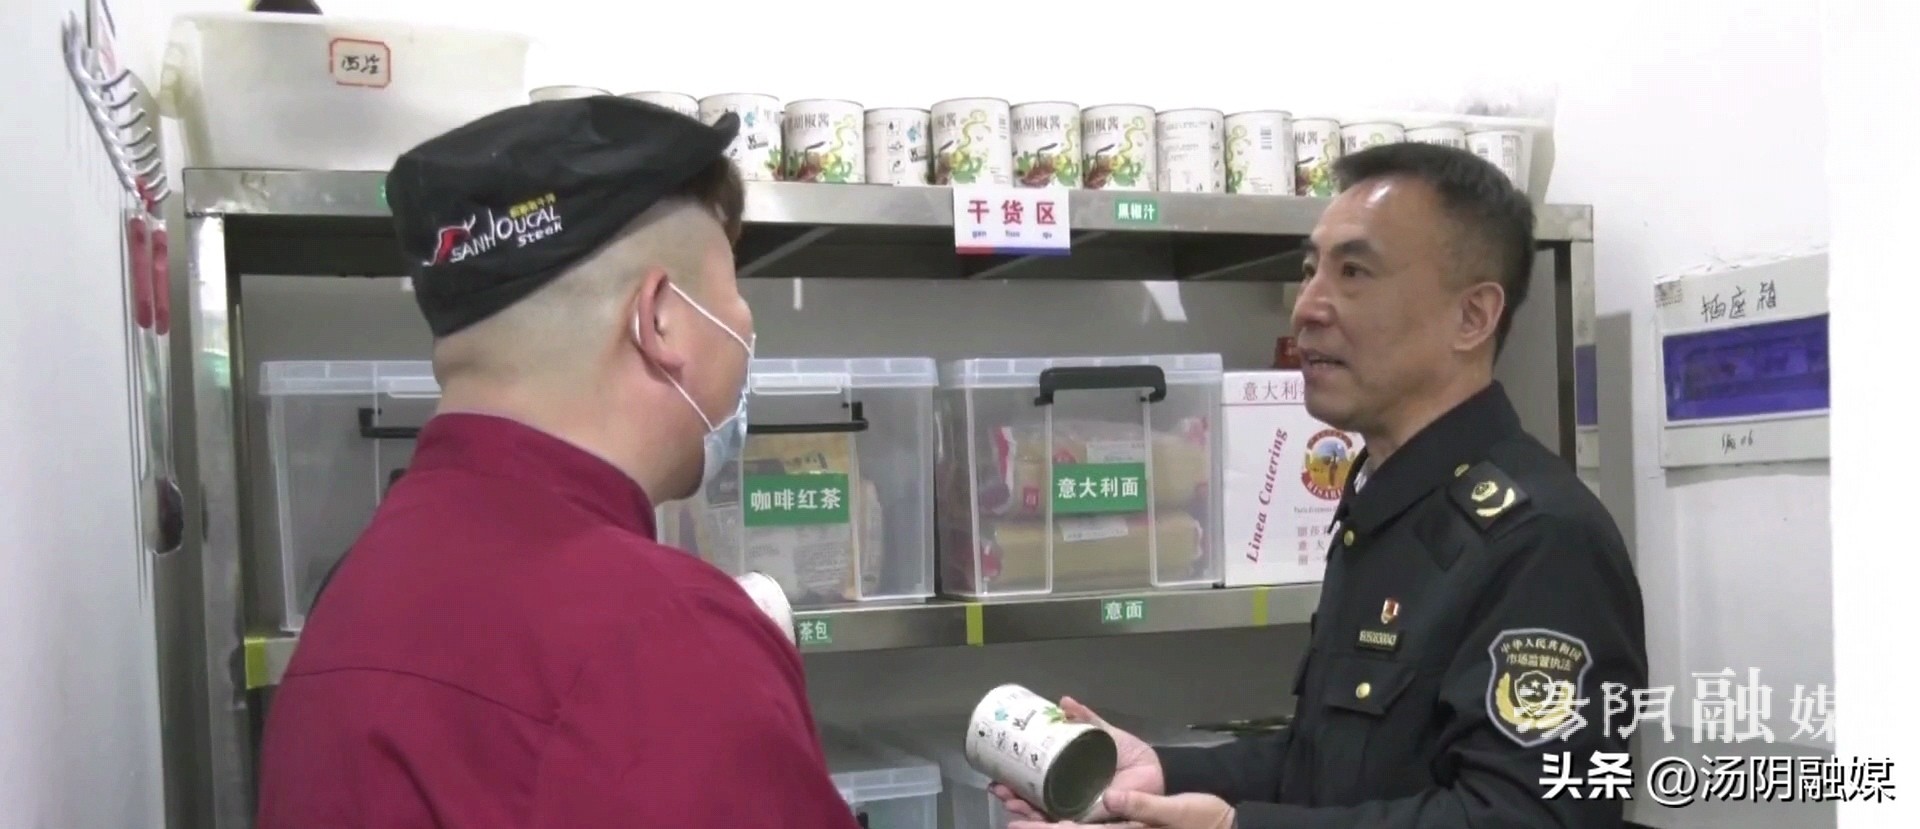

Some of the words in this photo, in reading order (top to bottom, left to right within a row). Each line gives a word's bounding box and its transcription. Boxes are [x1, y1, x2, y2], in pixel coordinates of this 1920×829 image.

[967, 200, 1056, 225] 干货区
[750, 487, 841, 512] 咖啡红茶
[1057, 476, 1139, 499] 意大利面
[1246, 512, 1268, 565] Linea
[1258, 427, 1288, 507] Catering
[1104, 602, 1144, 621] 意面
[799, 619, 828, 641] 茶包
